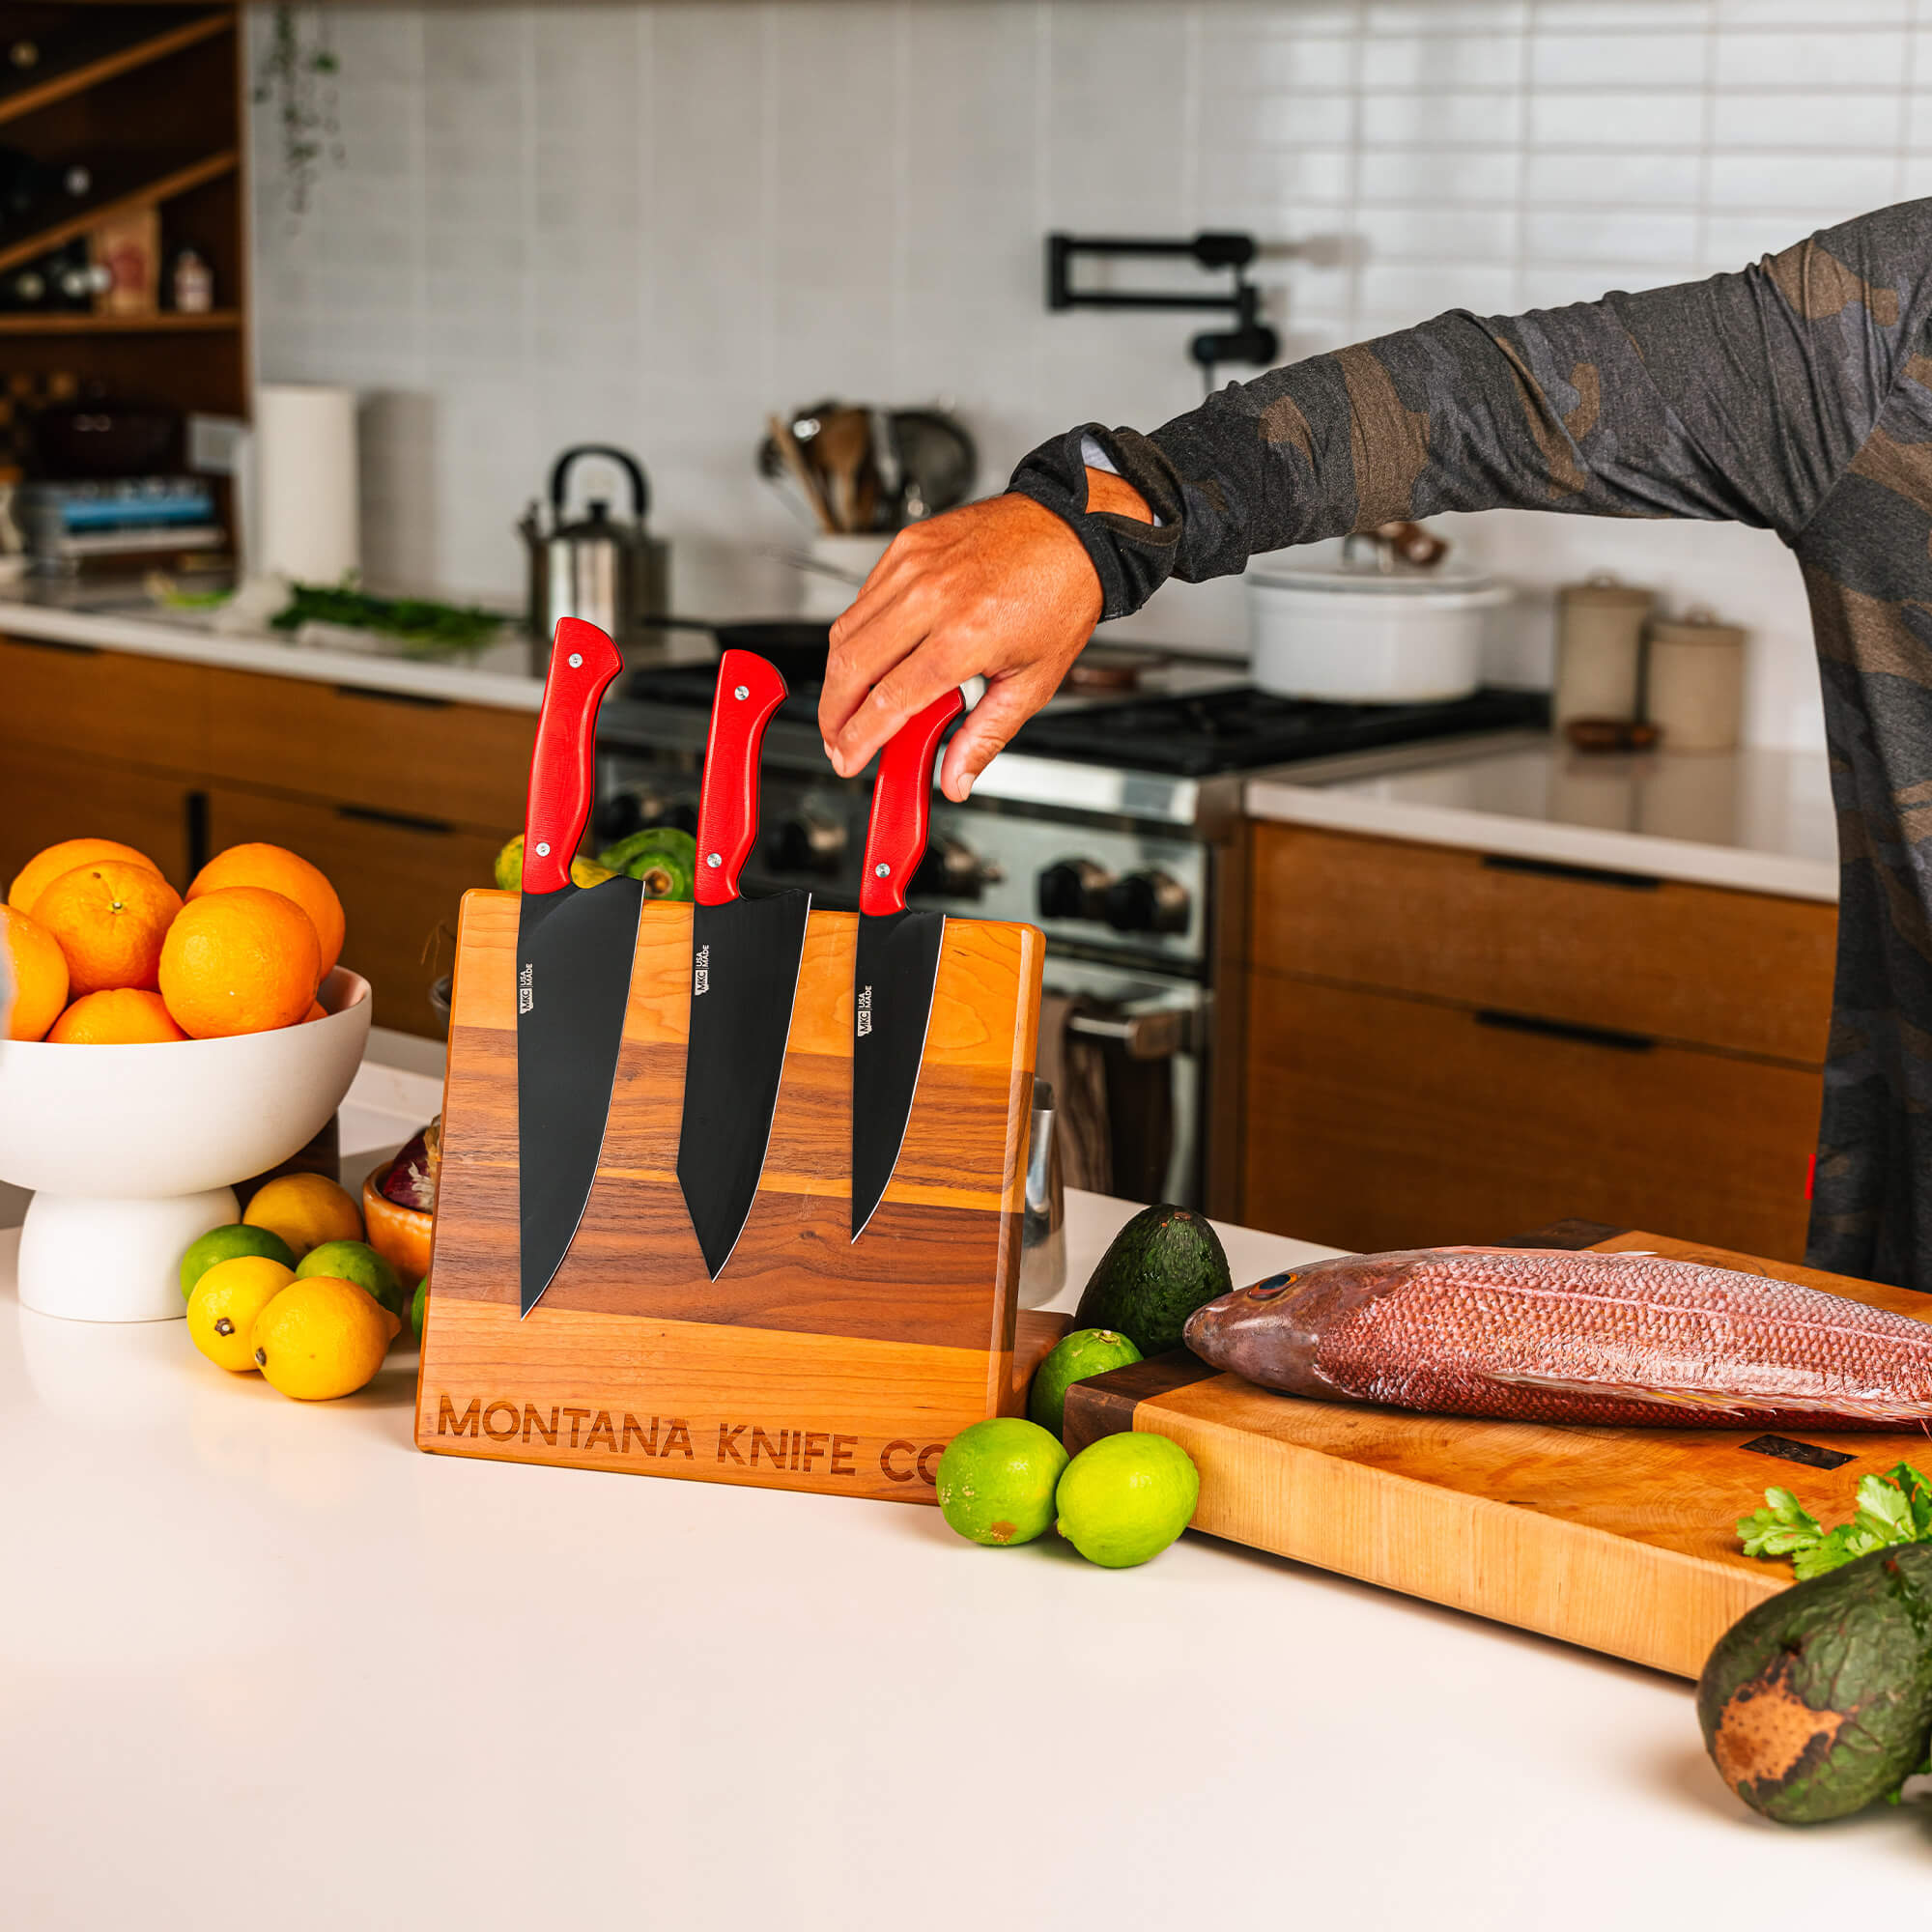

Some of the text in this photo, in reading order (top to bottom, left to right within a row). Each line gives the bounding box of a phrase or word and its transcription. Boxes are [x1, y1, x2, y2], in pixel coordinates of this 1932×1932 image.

[696, 971, 707, 992] MKC
[521, 989, 531, 1010] MKC
[859, 1011, 869, 1033] MKC
[438, 1395, 695, 1461] MONTANA
[717, 1422, 859, 1476] KNIFE
